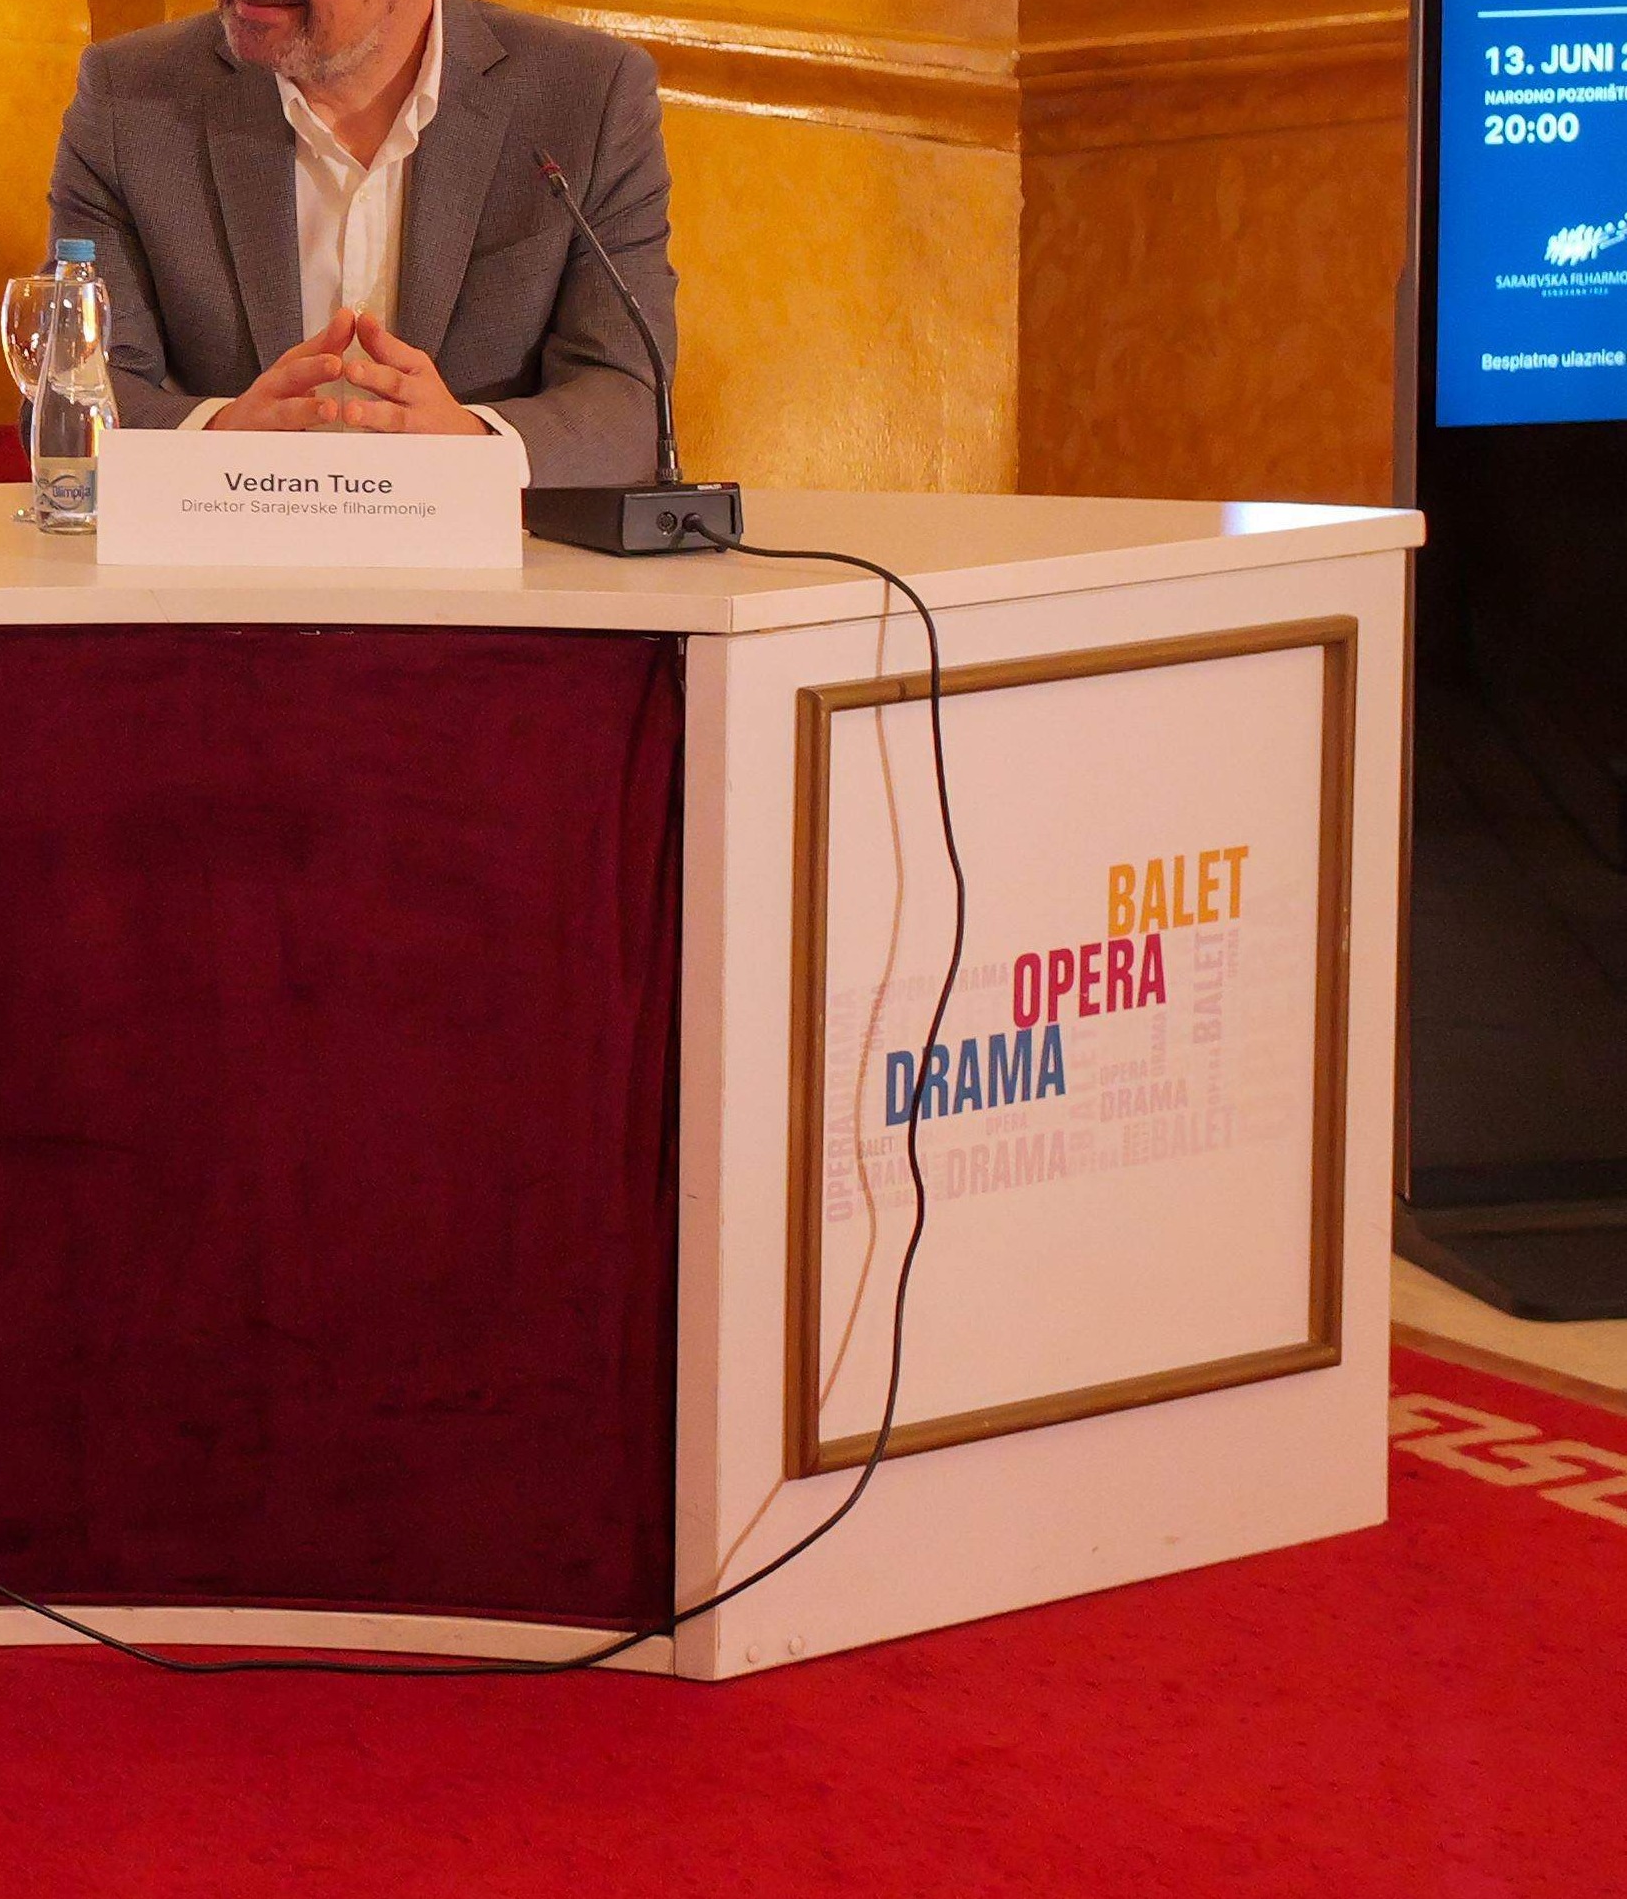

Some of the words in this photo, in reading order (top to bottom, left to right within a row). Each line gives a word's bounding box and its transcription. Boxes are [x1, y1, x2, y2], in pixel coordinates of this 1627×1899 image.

[1485, 45, 1535, 76] 13.
[1540, 42, 1614, 74] JUNI
[1485, 88, 1556, 106] NARODNO
[1484, 112, 1580, 145] 20:00
[224, 472, 320, 492] Vedran
[327, 474, 393, 494] Tuce
[181, 499, 246, 513] Direktor
[250, 500, 338, 516] Sarajevske
[343, 500, 437, 518] filharmonije
[1108, 845, 1249, 938] BALET
[1012, 933, 1166, 1030] OPERA
[885, 1023, 1067, 1128] DRAMA
